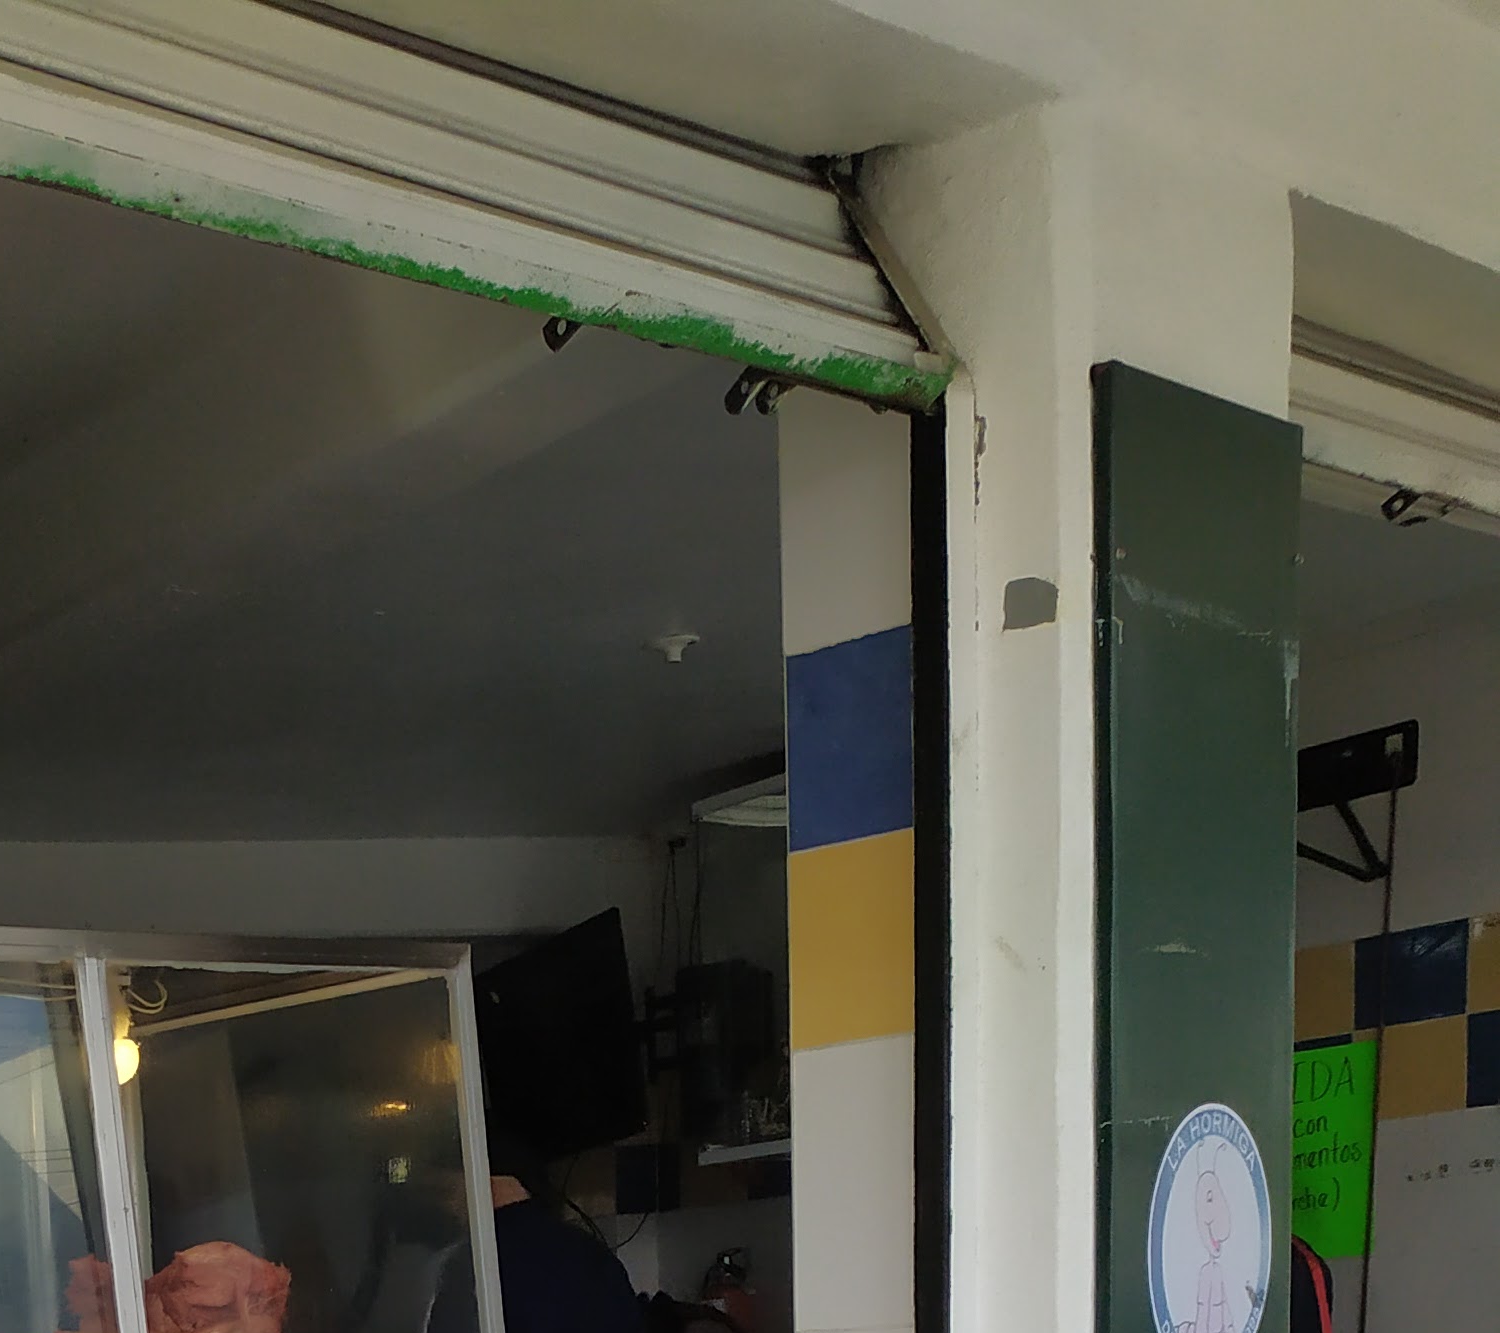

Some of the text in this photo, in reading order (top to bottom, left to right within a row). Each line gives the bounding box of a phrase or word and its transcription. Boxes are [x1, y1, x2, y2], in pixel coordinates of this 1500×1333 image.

[1167, 1110, 1256, 1172] LA HORMIGA
[1293, 1115, 1328, 1138] con
